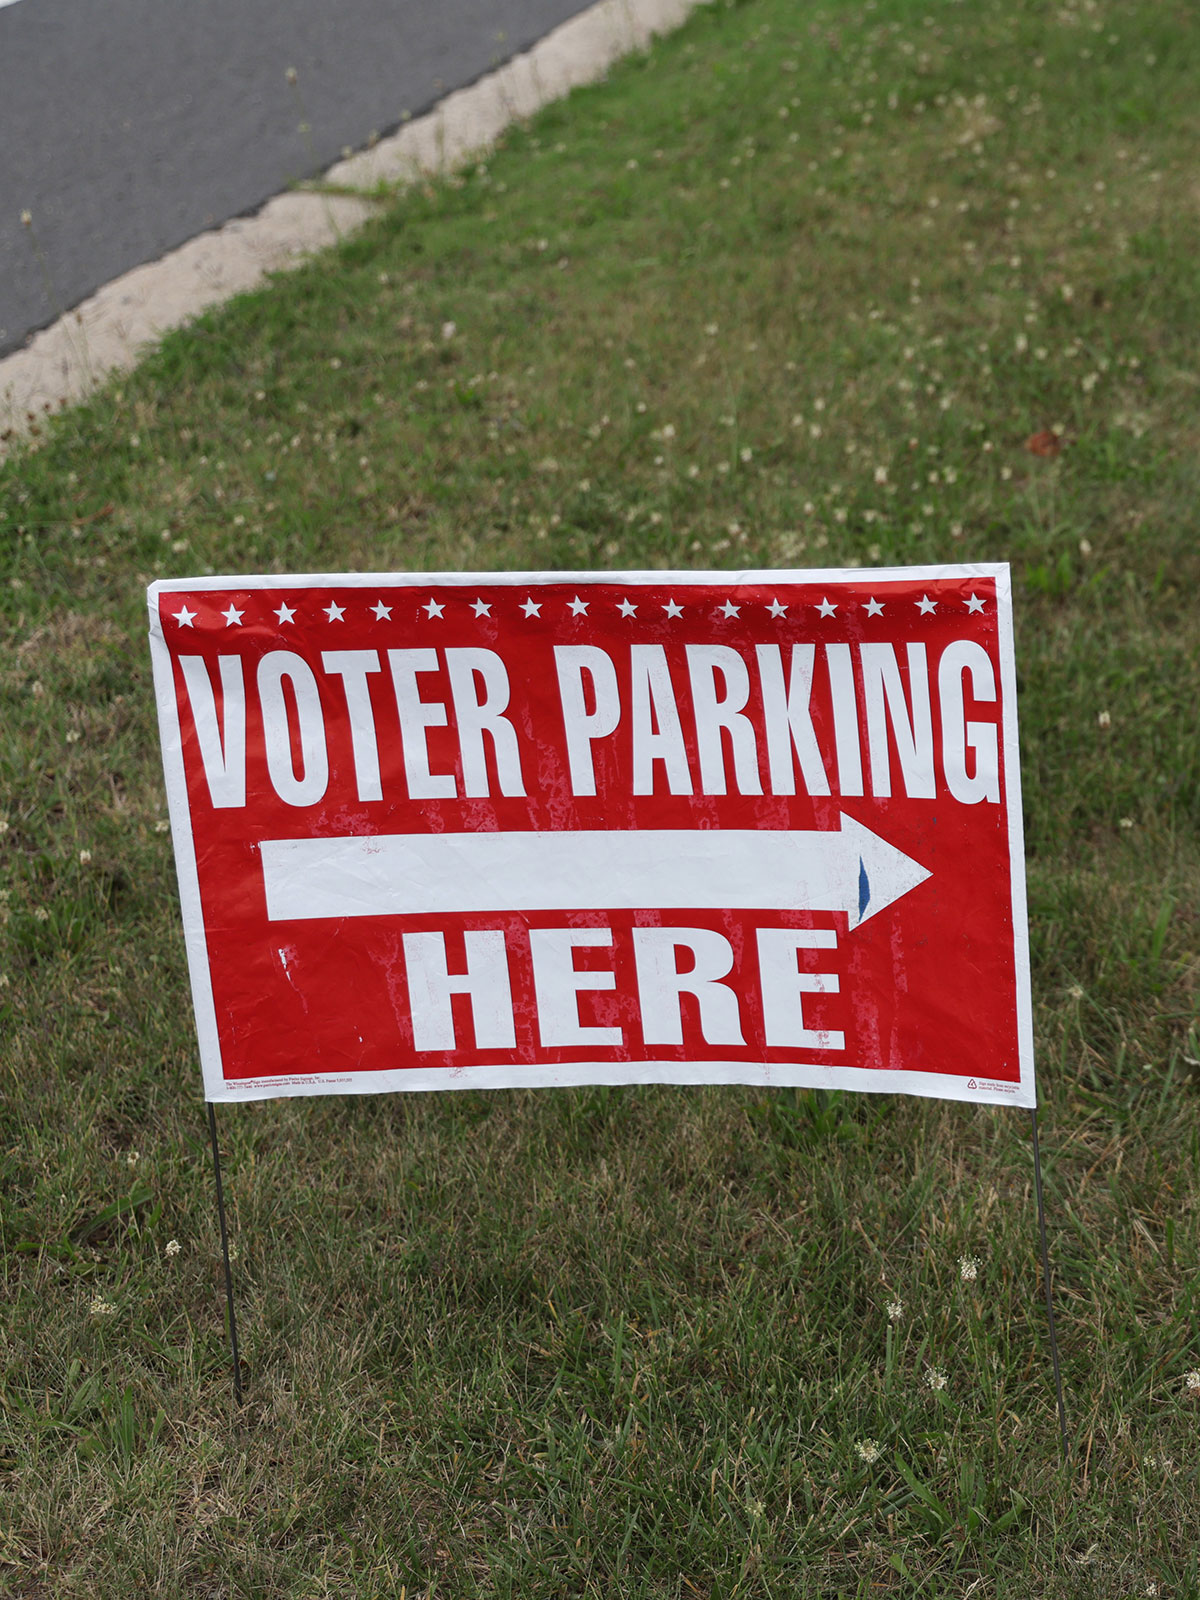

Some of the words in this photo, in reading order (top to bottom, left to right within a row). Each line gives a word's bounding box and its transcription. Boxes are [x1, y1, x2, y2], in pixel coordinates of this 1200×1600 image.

[177, 647, 528, 809] VOTER
[552, 639, 1001, 805] PARKING
[401, 926, 846, 1052] HERE
